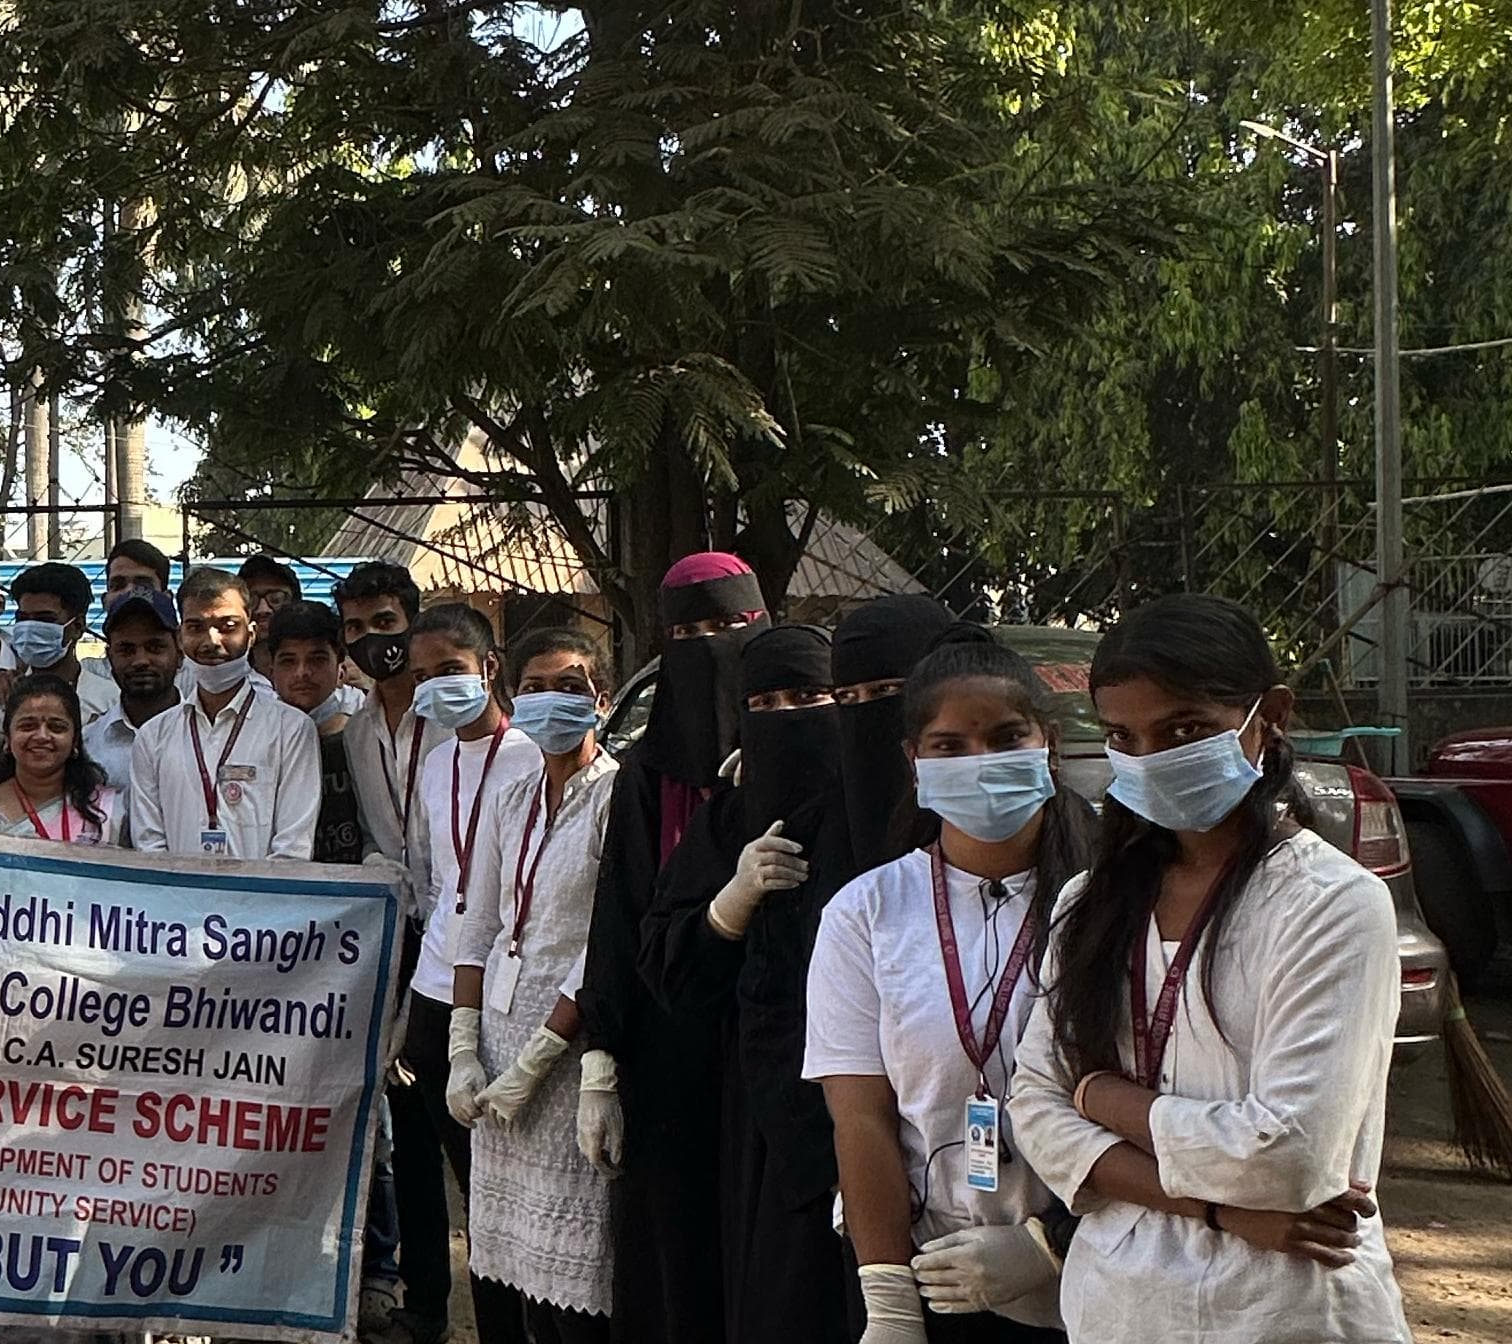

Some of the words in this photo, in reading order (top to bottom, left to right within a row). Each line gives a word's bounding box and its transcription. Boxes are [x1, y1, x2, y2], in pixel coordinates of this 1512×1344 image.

[88, 902, 188, 957] Mitra
[0, 970, 150, 1036] College
[163, 985, 353, 1040] Bhiwandi.
[3, 1037, 65, 1068] C.A.
[75, 1042, 205, 1077] SURESH
[213, 1051, 287, 1086] JAIN
[132, 1090, 332, 1153] SCHEME
[97, 1157, 134, 1185] OF
[141, 1161, 279, 1197] STUDENTS
[73, 1194, 197, 1238] SERVICE)
[97, 1240, 206, 1298] YOU
